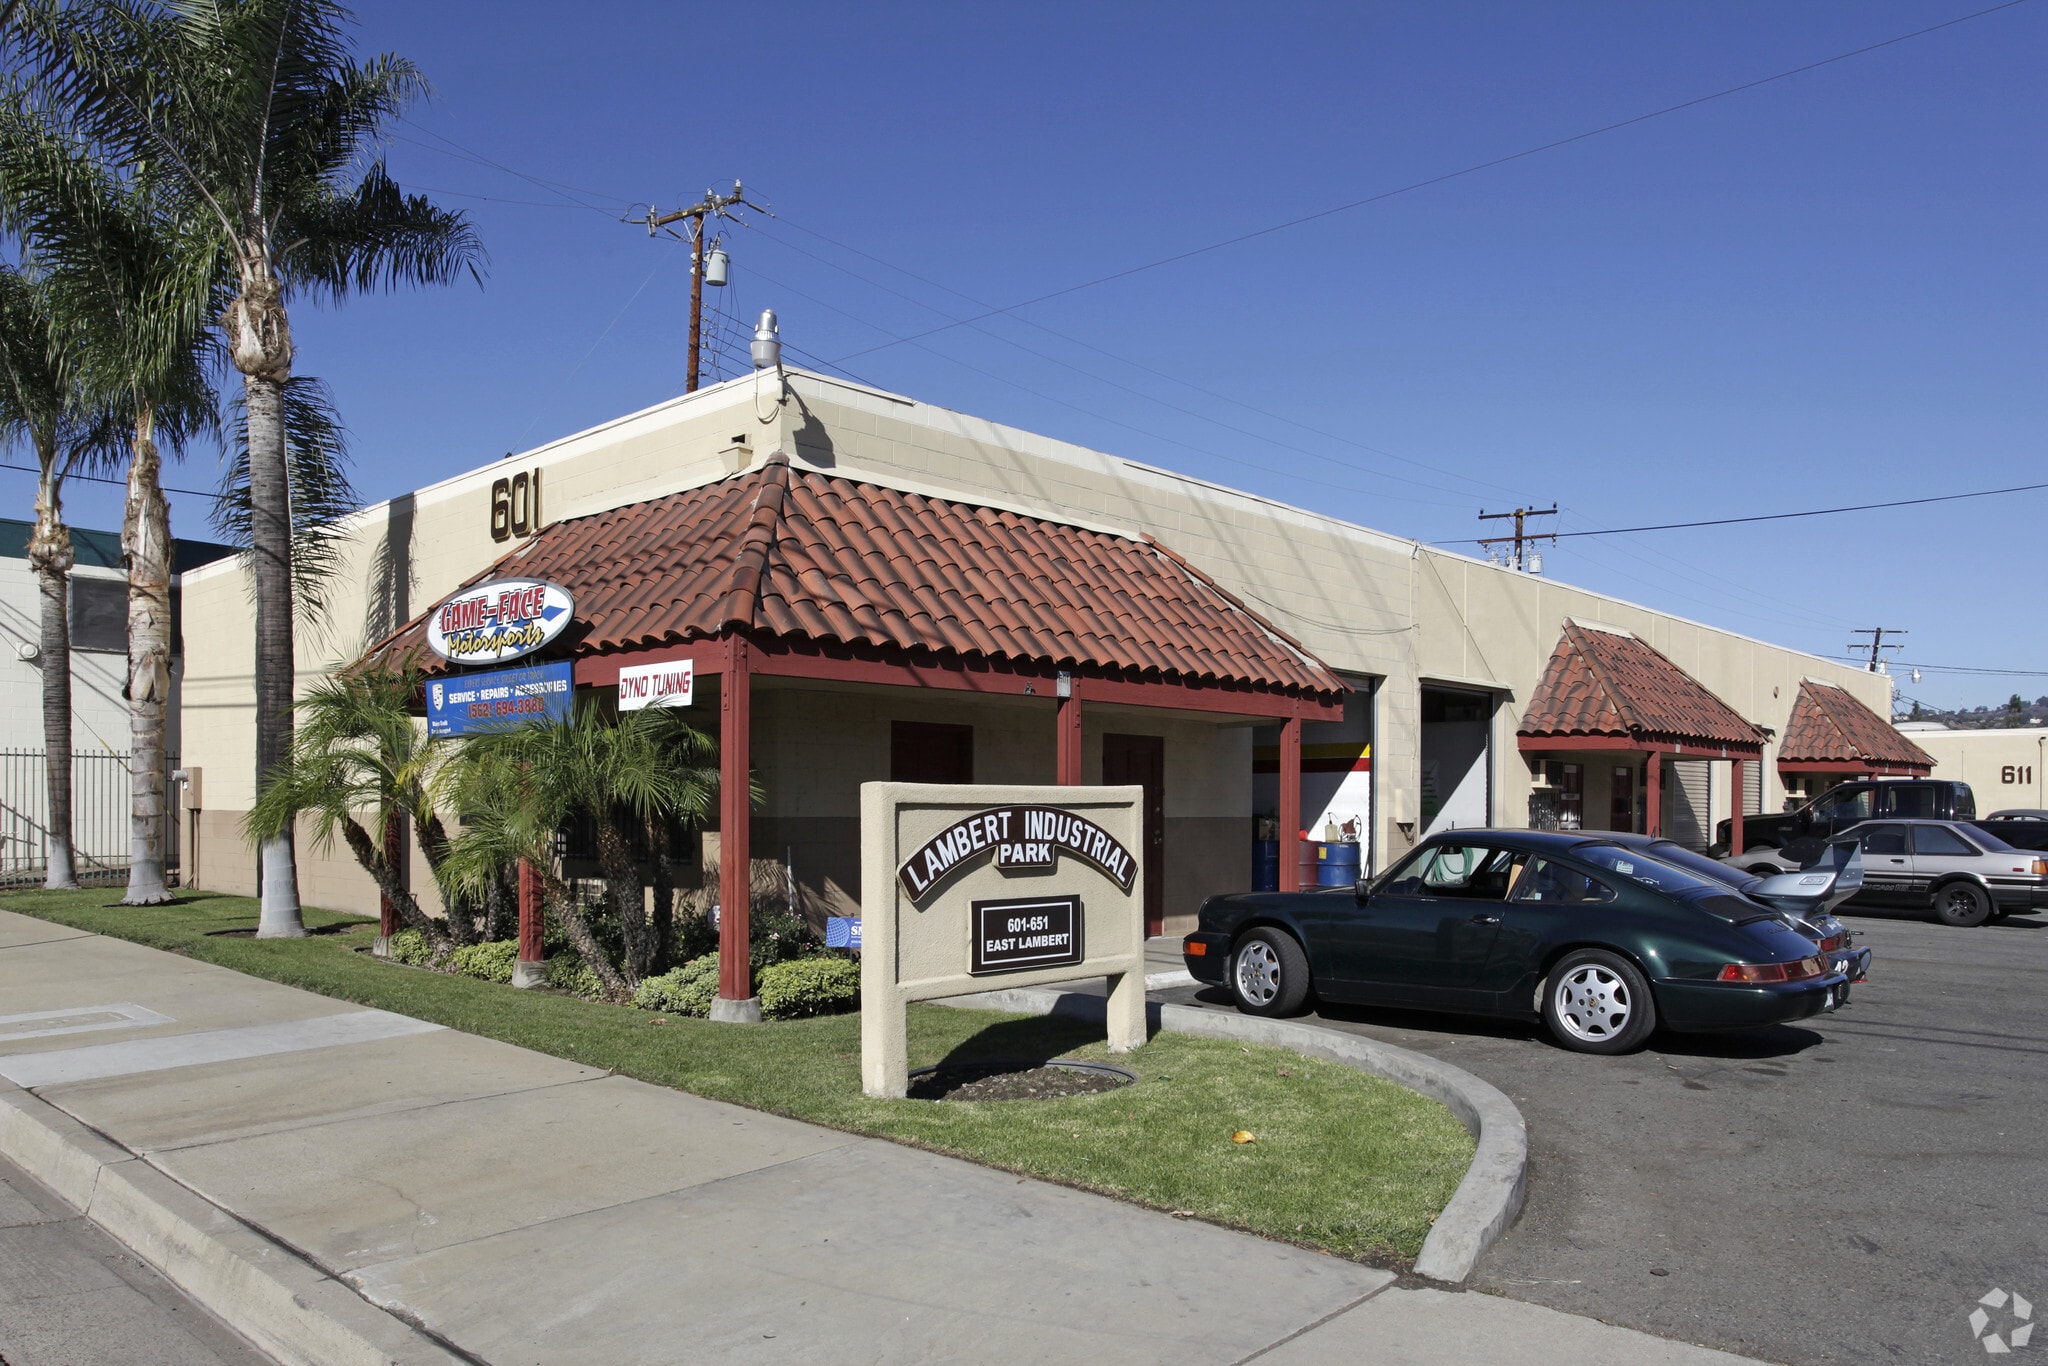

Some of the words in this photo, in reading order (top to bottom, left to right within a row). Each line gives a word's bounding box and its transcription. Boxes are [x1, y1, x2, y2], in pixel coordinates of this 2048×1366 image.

[491, 467, 541, 541] 601
[440, 584, 546, 634] GAME-FACE
[447, 621, 544, 658] Motorsports
[448, 691, 476, 704] SERVICE
[480, 687, 509, 700] REPAIRS
[620, 675, 649, 699] DYNO
[653, 671, 691, 696] TUNING
[2001, 765, 2032, 785] 611
[907, 811, 1012, 892] LAMBERT
[1024, 810, 1130, 883] INDUSTRIAL
[1000, 843, 1051, 864] PARK
[1007, 915, 1049, 933] 601-651
[986, 938, 1016, 952] EAST
[1018, 933, 1069, 949] LAMBERT
